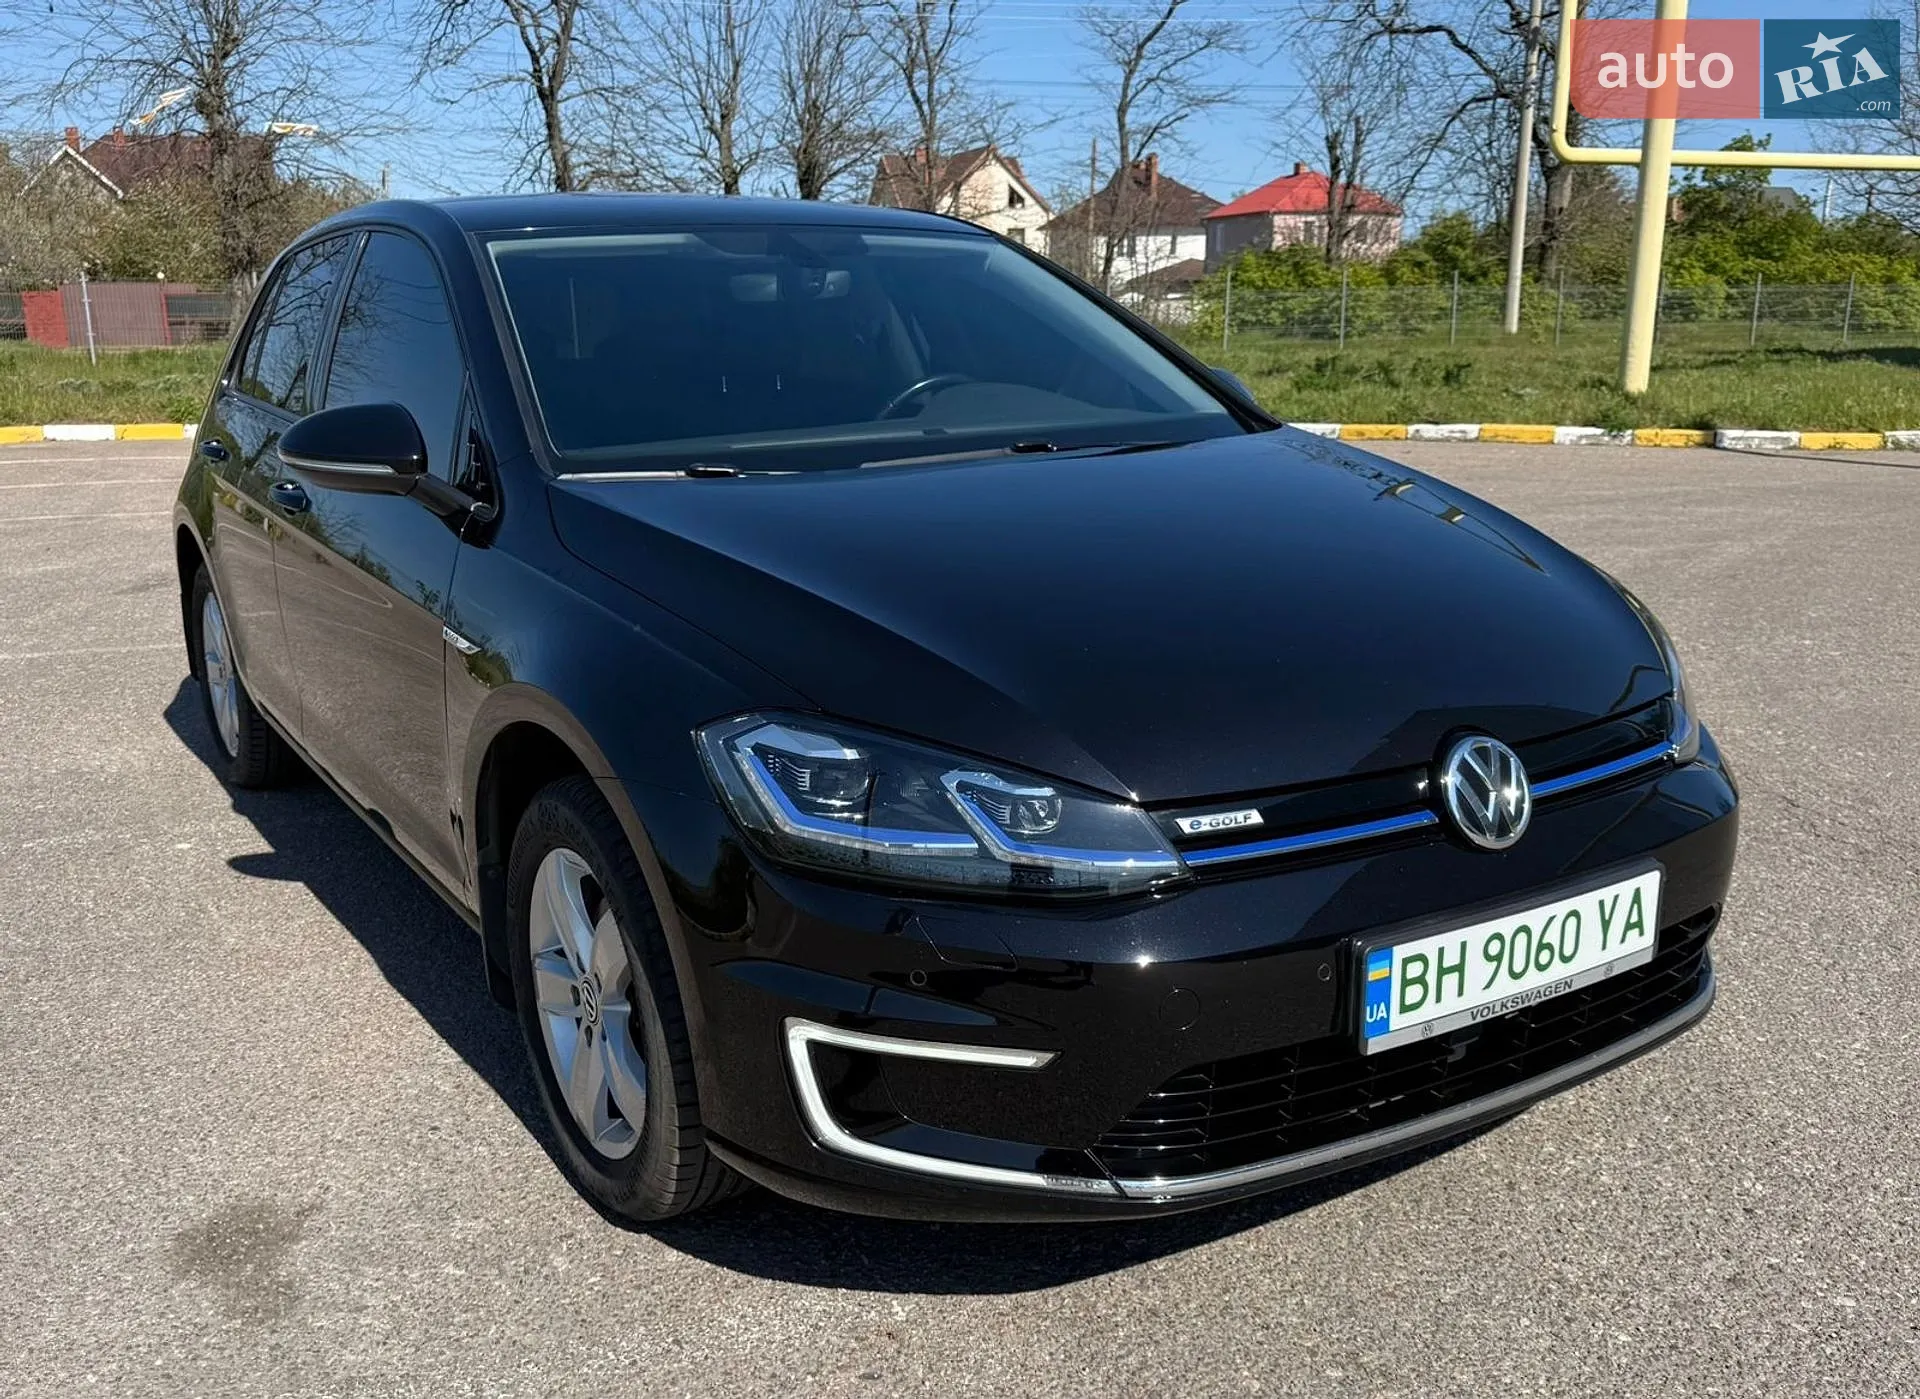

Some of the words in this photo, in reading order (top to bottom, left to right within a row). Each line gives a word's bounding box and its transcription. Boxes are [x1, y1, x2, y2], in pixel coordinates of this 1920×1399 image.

[1189, 813, 1252, 830] e-GOLF
[1398, 940, 1467, 1015] BH
[1481, 908, 1582, 991] 9060
[1598, 886, 1645, 951] YA
[1365, 1003, 1388, 1024] UA
[1469, 978, 1575, 1022] VOLKSWAGEN
